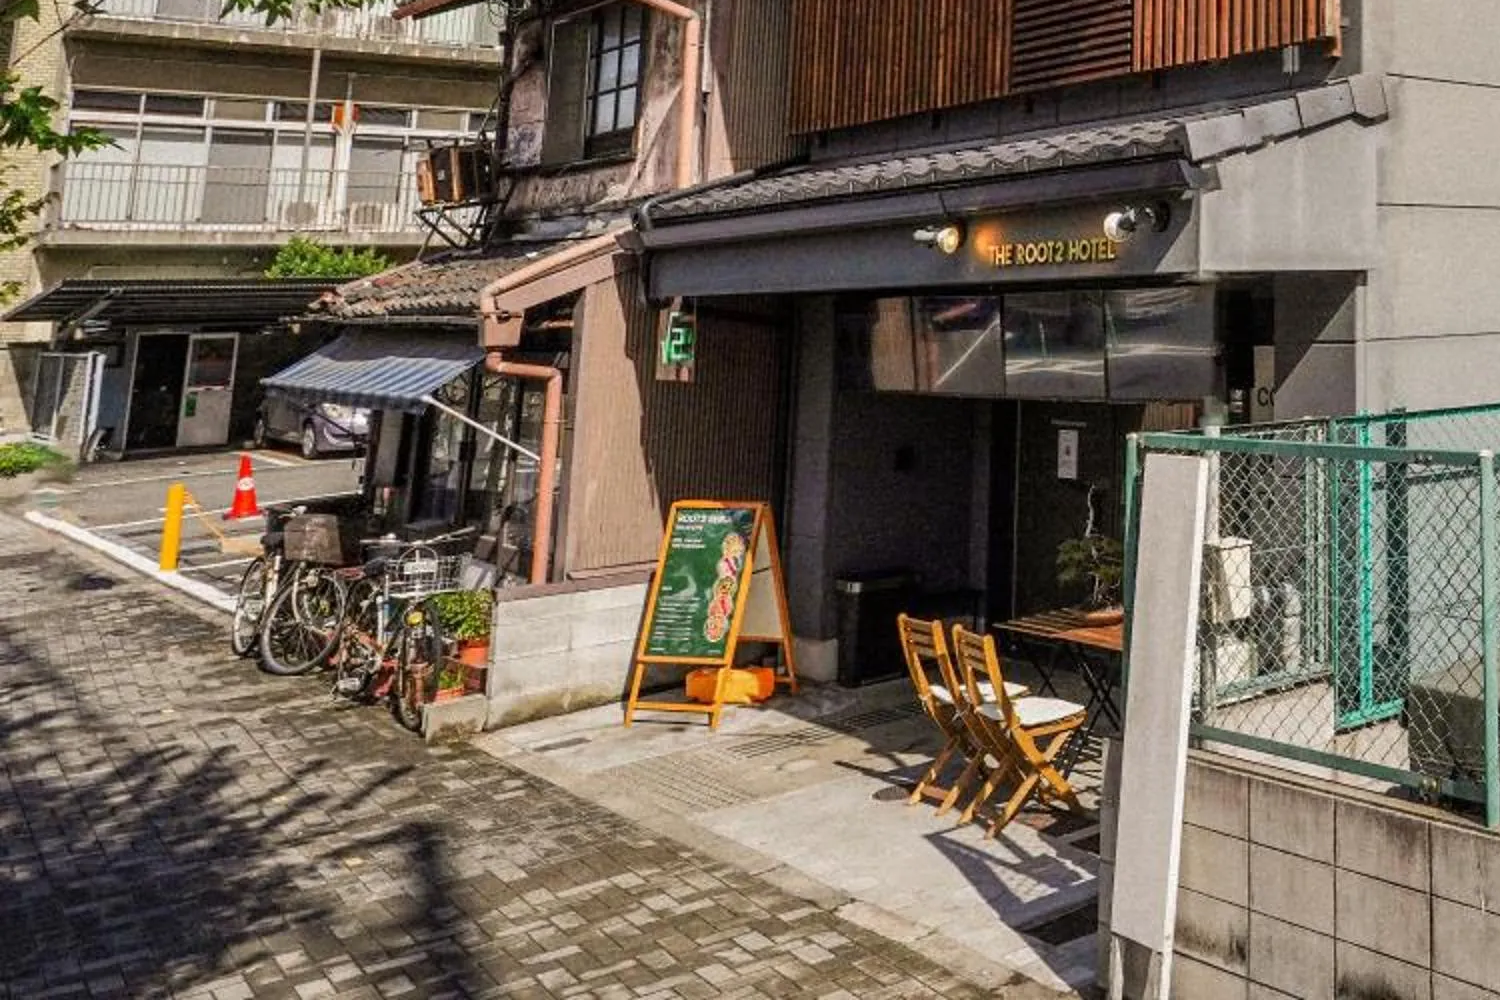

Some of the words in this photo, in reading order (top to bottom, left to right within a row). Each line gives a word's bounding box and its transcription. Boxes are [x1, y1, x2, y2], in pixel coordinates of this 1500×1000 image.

[988, 244, 1013, 265] THE
[1016, 241, 1065, 265] ROOT2
[1068, 238, 1116, 261] HOTEL
